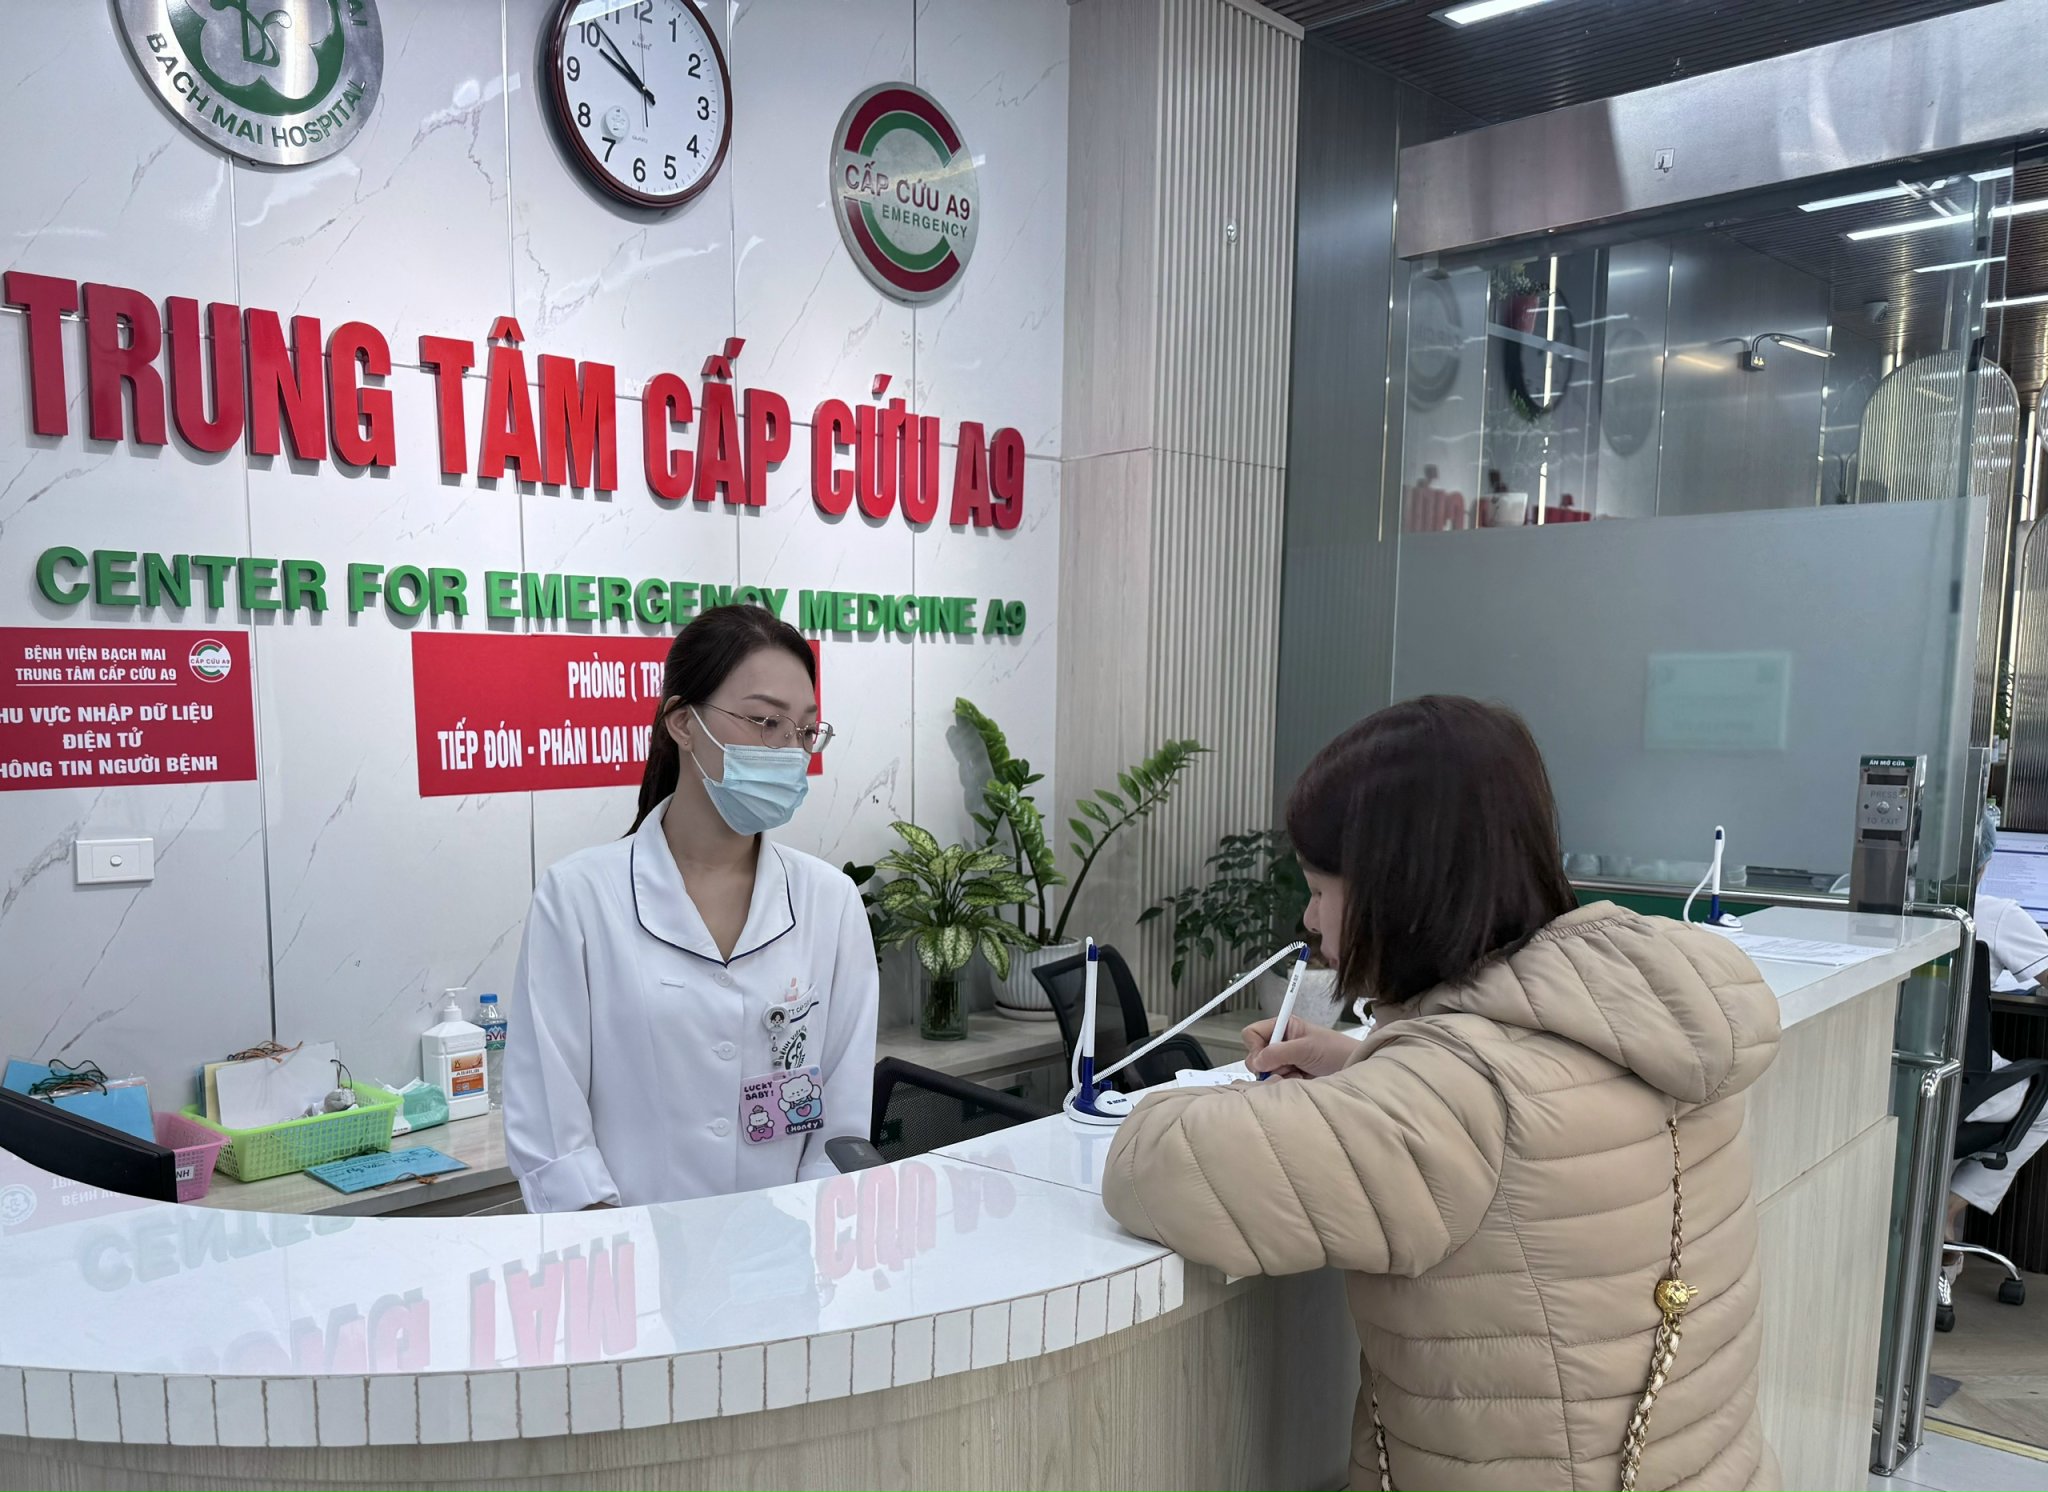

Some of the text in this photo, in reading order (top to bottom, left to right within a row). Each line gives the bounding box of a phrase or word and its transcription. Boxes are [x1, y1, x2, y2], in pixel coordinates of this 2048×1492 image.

[578, 22, 601, 48] 10
[668, 18, 677, 43] 1
[566, 56, 581, 82] 9
[687, 53, 702, 80] 2
[146, 32, 367, 148] BACH MAI HOSPITAL
[577, 102, 592, 128] 8
[696, 96, 710, 121] 3
[601, 136, 617, 163] 7
[686, 134, 700, 159] 4
[632, 157, 646, 183] 6
[663, 154, 677, 180] 5
[844, 160, 971, 221] CẤP CỨU A9
[881, 203, 968, 239] EMERGENCY
[3, 270, 1025, 531] TRUNG TÂM CẤP CỨU A9
[35, 545, 330, 613] CENTER
[347, 562, 470, 616] FOR
[798, 588, 978, 635] MEDICINE
[982, 598, 1027, 636] A9
[24, 644, 166, 664] BỆNH VIỆN BẠCH MAI
[15, 664, 177, 681] TRUNG TÂM CẤP CỨU A9
[568, 652, 625, 699] PHÒNG
[29, 705, 71, 726] VỰC
[78, 703, 134, 725] NHẬP
[140, 703, 168, 721] DỮ
[172, 701, 213, 723] LIỆU
[62, 726, 144, 752] ĐIỆN TỬ
[437, 717, 479, 771] TIẾP
[484, 720, 523, 769] ĐÓN
[539, 719, 588, 766] PHÂN
[592, 725, 629, 771] LOẠI
[59, 759, 93, 776] TIN
[99, 754, 160, 775] NGƯỜI
[166, 753, 218, 775] BỆNH
[1870, 790, 1898, 799] PRESS
[1866, 817, 1899, 826] TO EXIT
